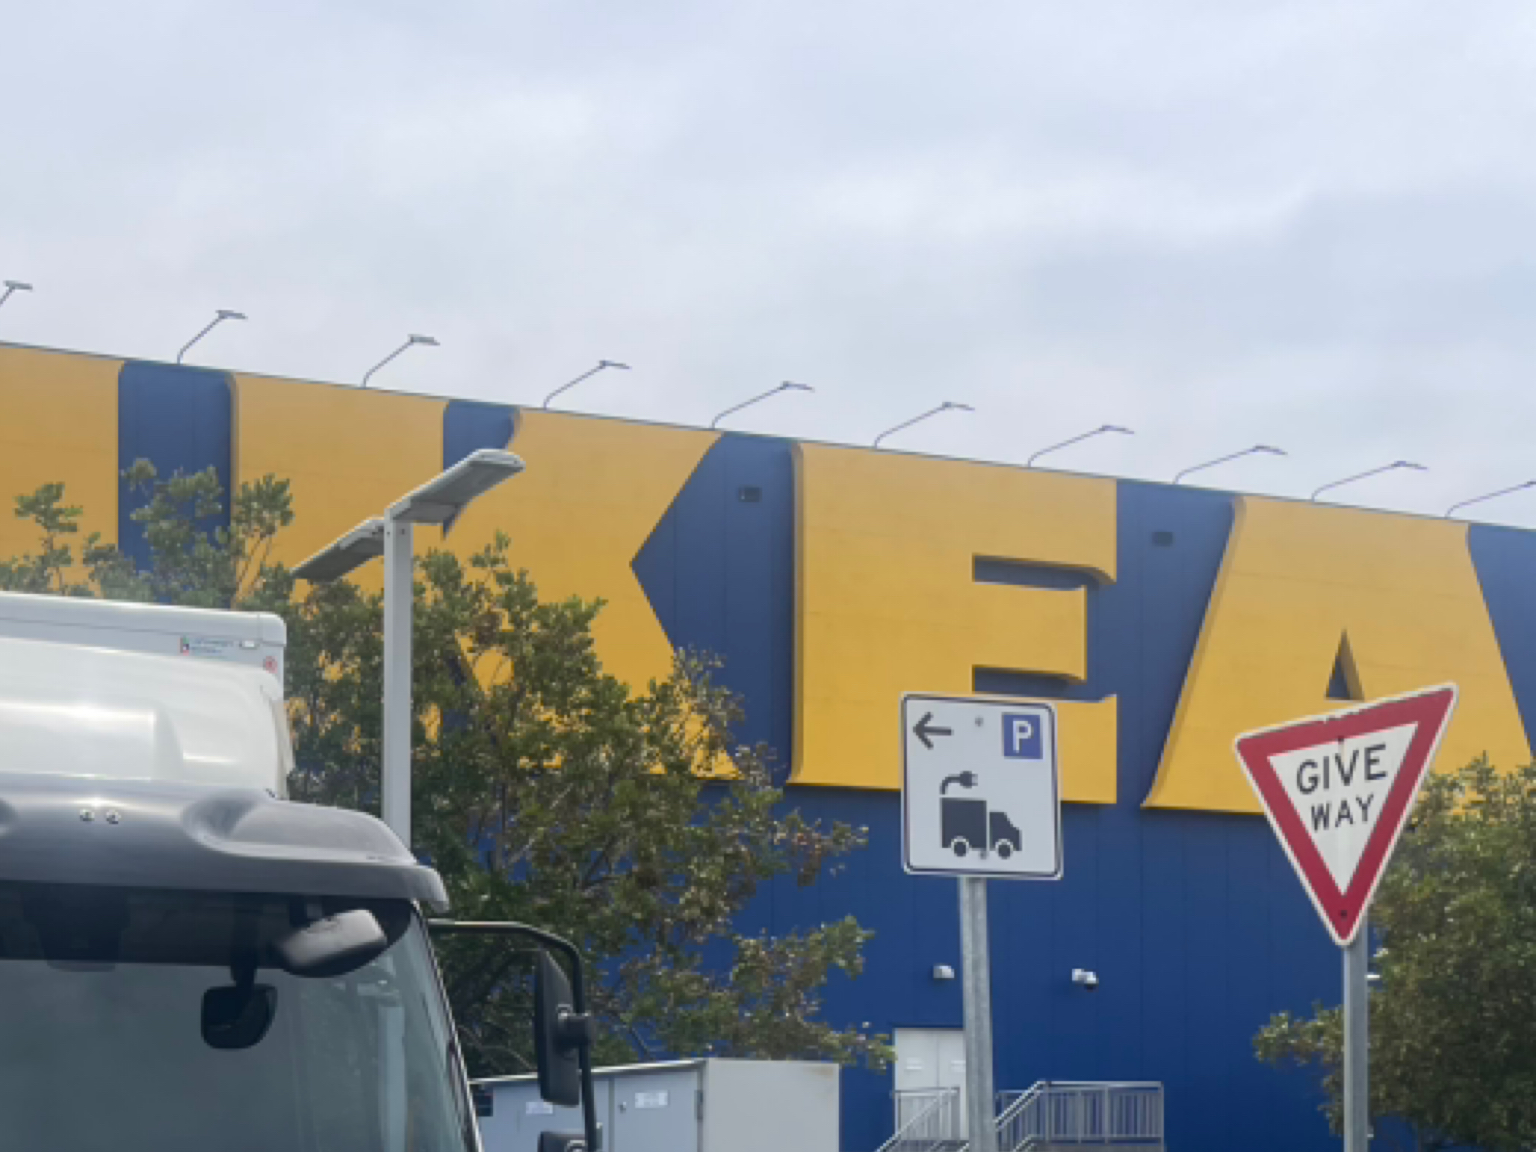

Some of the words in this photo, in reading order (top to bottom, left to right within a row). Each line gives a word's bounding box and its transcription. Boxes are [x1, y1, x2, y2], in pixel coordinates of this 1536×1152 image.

[1012, 719, 1033, 753] P
[1297, 743, 1387, 795] GIVE
[1311, 793, 1374, 833] WAY
